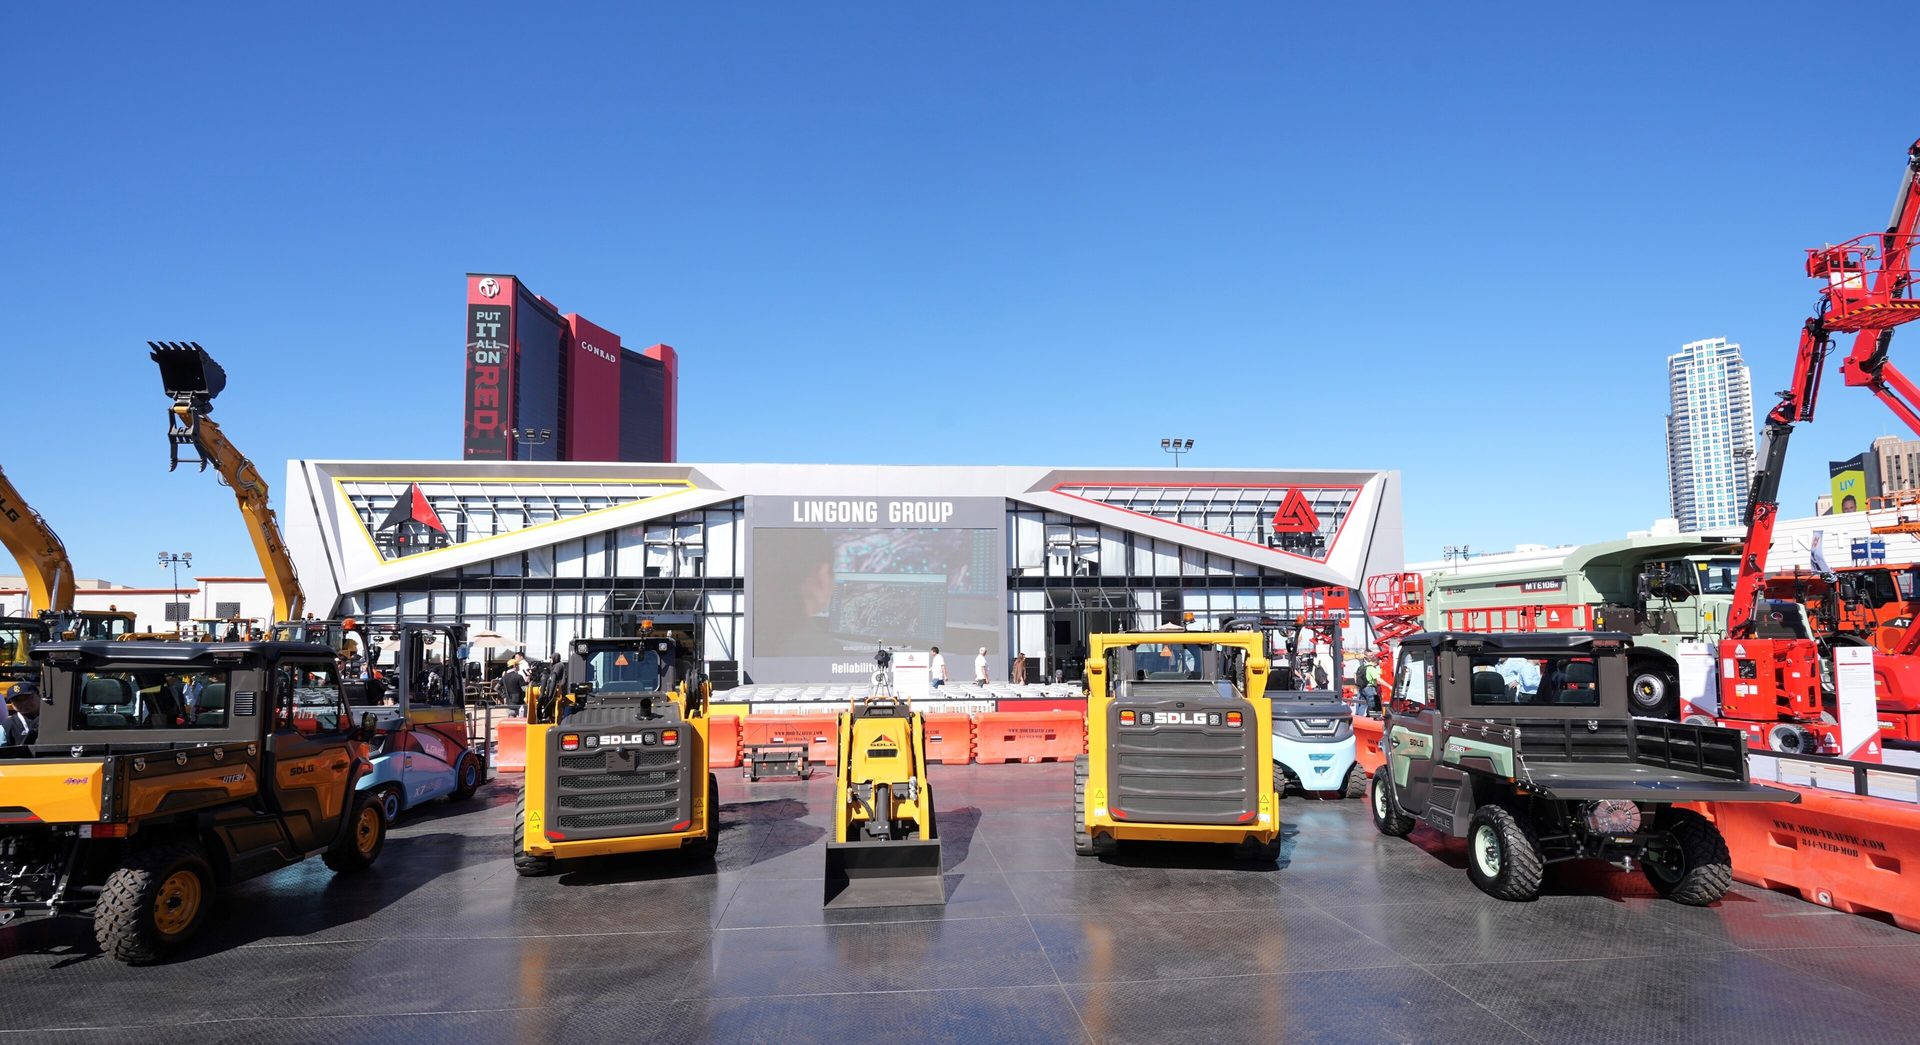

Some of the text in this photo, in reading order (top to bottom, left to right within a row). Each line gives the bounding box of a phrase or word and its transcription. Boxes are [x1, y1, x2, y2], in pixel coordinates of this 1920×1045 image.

[476, 311, 501, 321] PUT
[475, 323, 501, 338] IT
[476, 339, 500, 349] ALL
[475, 351, 500, 364] ON
[581, 341, 616, 363] CONRAD
[473, 366, 500, 431] RED
[1839, 478, 1855, 491] LIV
[0, 495, 20, 523] LG
[793, 500, 953, 523] LINGONG GROUP
[1154, 712, 1207, 725] SDLG
[600, 734, 642, 745] SDLG
[1409, 738, 1424, 748] SDLG
[290, 765, 314, 776] SDLG
